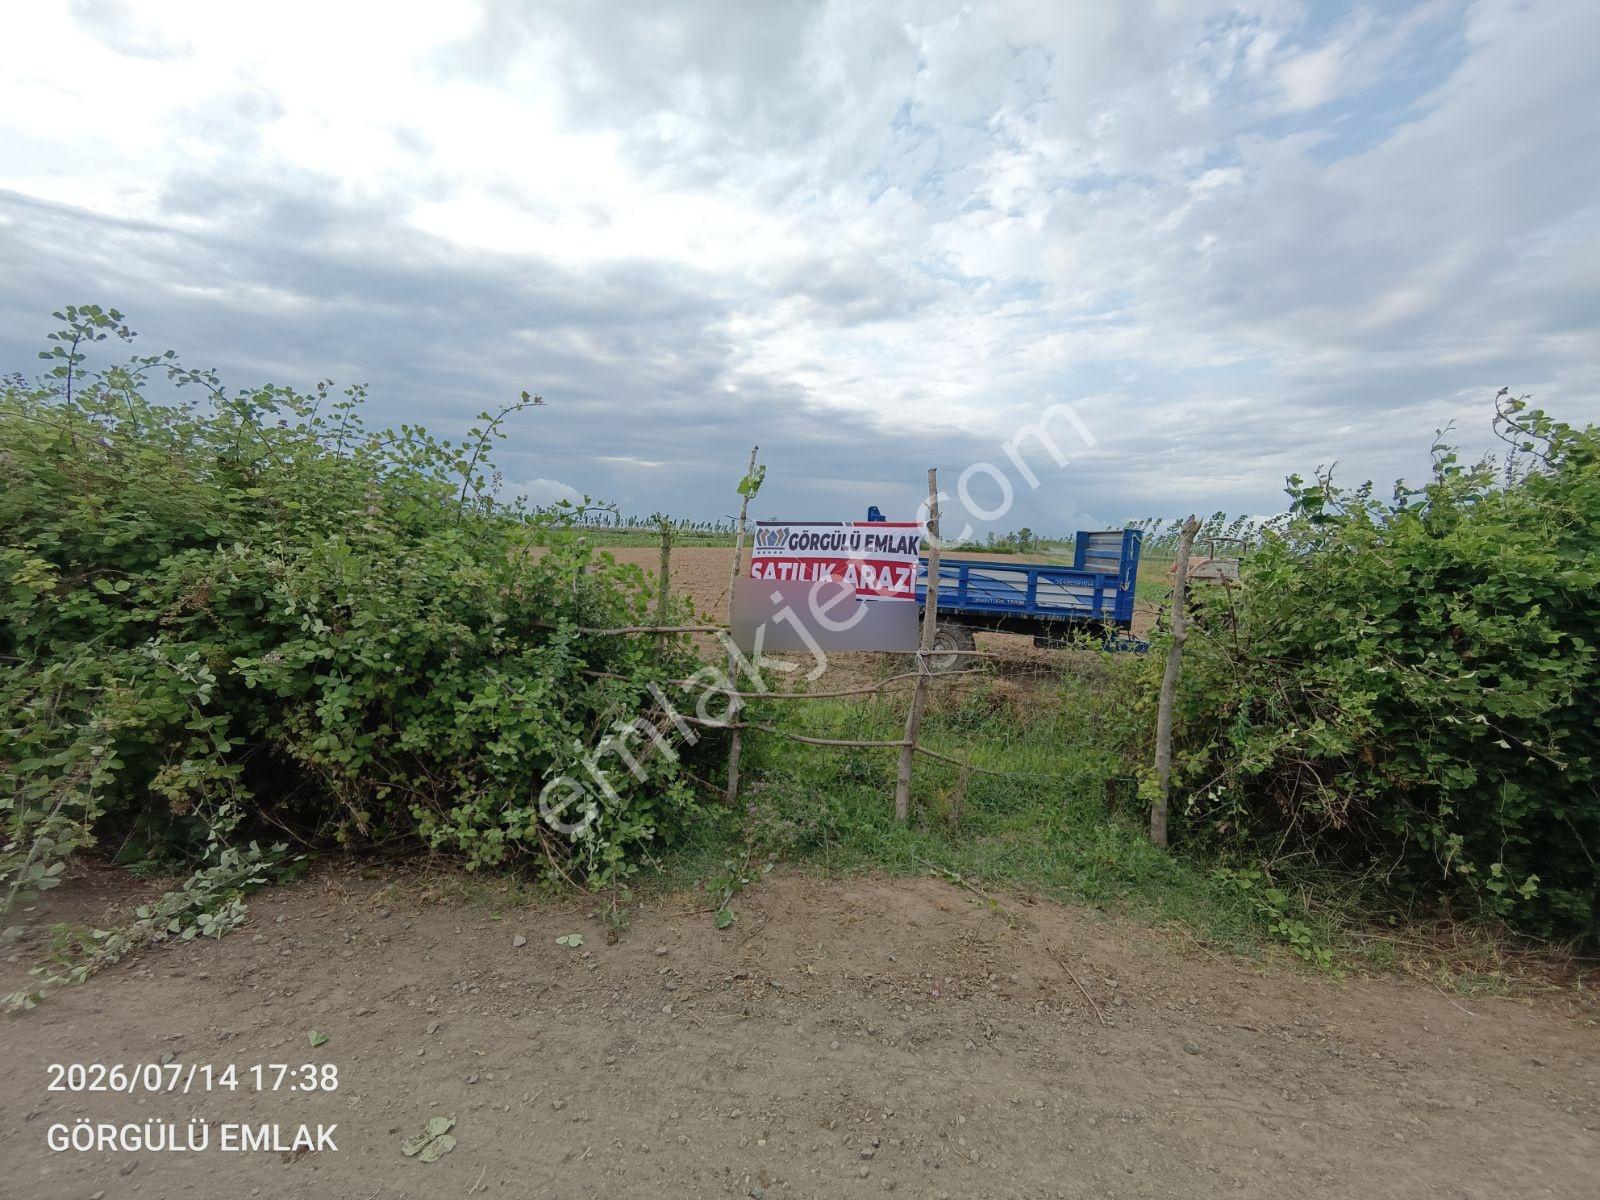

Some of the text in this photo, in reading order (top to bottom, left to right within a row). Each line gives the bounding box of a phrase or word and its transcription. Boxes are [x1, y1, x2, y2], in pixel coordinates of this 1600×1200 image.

[789, 529, 919, 556] GÖRGÜLÜ EMLAK
[843, 563, 918, 593] ARAZİ
